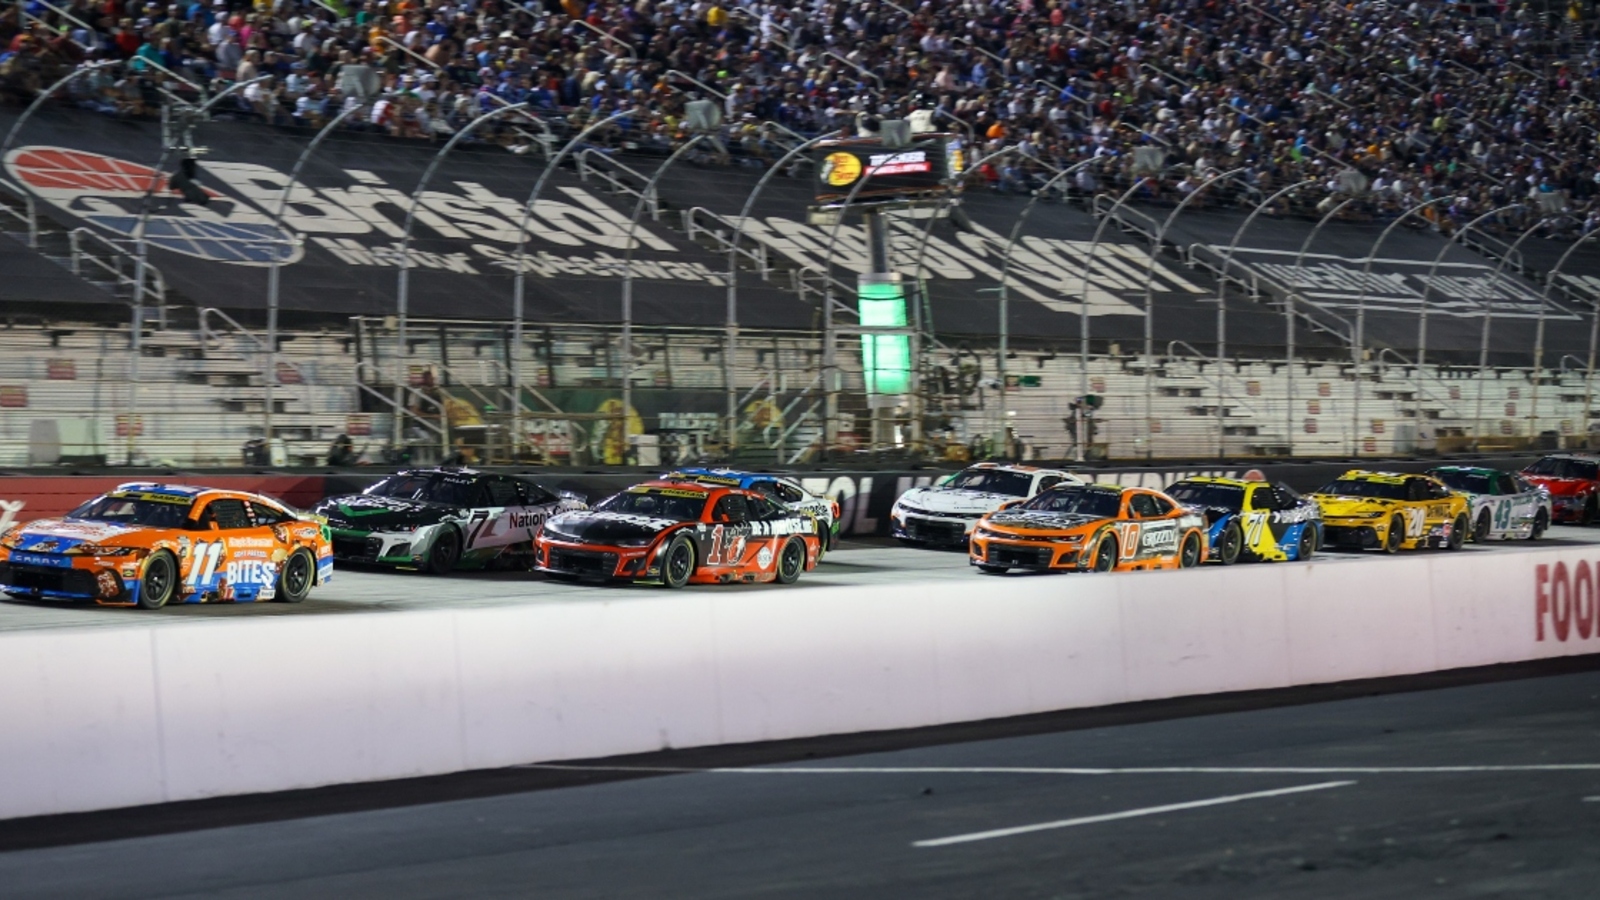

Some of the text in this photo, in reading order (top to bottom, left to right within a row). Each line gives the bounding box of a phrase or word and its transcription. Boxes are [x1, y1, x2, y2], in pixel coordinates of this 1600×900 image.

[194, 160, 680, 252] Bristol
[310, 236, 728, 287] Motor Speedway
[466, 509, 491, 549] 7
[509, 510, 551, 529] Nation
[1244, 513, 1267, 547] 71
[1407, 508, 1426, 537] 20
[1494, 499, 1512, 530] 43
[1119, 522, 1141, 560] 10
[14, 554, 61, 565] CAMRY
[186, 542, 223, 585] 11
[226, 559, 277, 585] BITES
[1535, 559, 1600, 642] FOO
